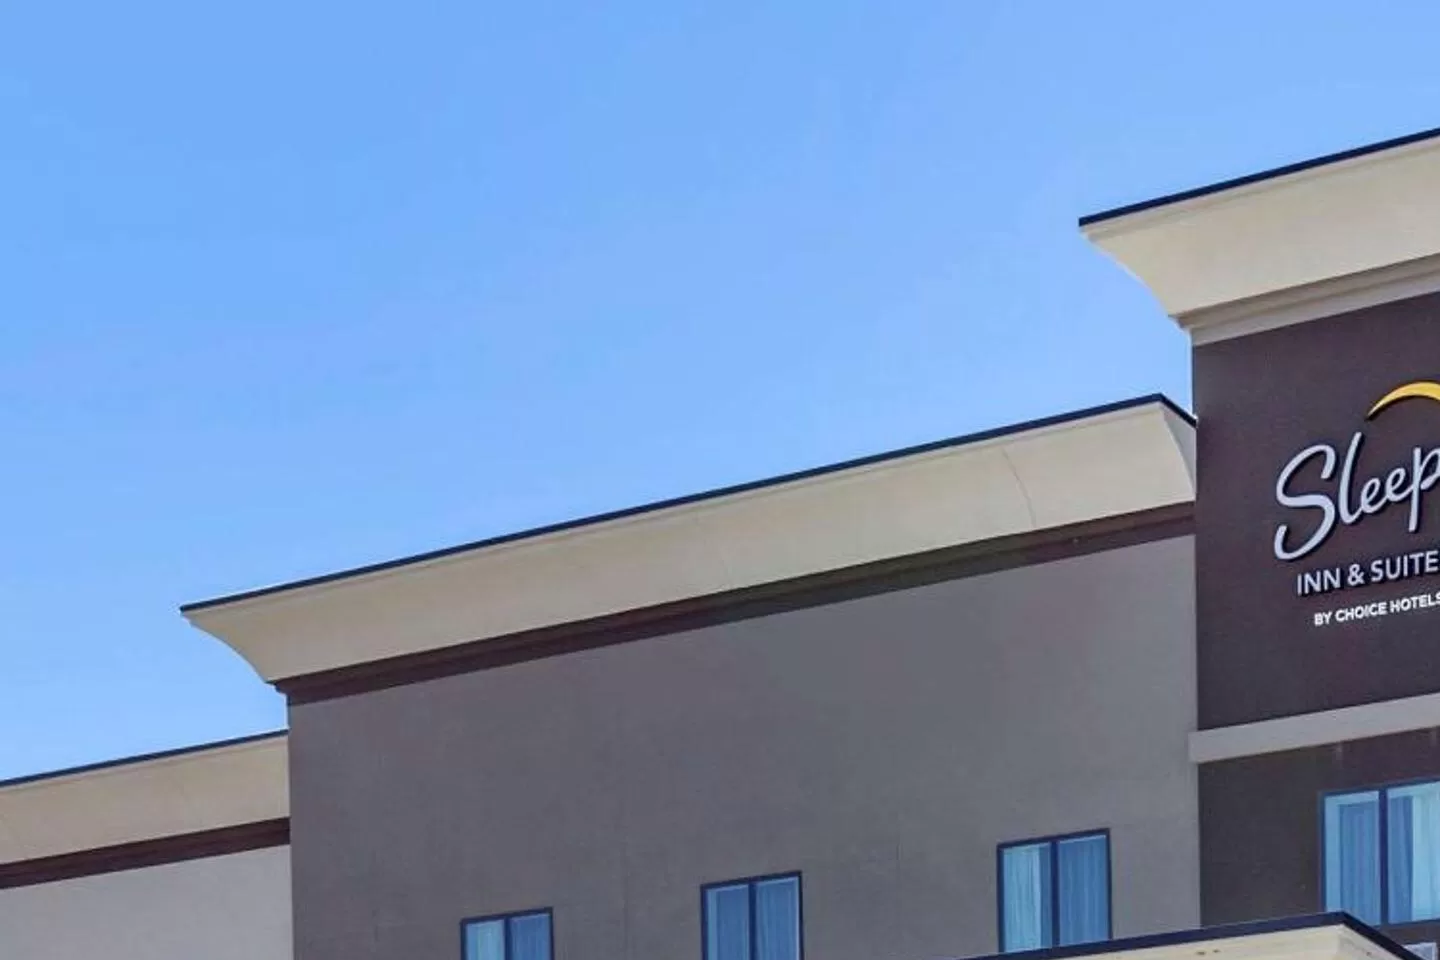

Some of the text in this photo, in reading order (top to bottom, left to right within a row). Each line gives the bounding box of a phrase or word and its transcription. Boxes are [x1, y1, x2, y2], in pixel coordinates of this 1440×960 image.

[1297, 567, 1342, 596] INN
[1347, 563, 1365, 587] &
[1314, 611, 1333, 627] BY
[1335, 601, 1388, 622] CHOICE
